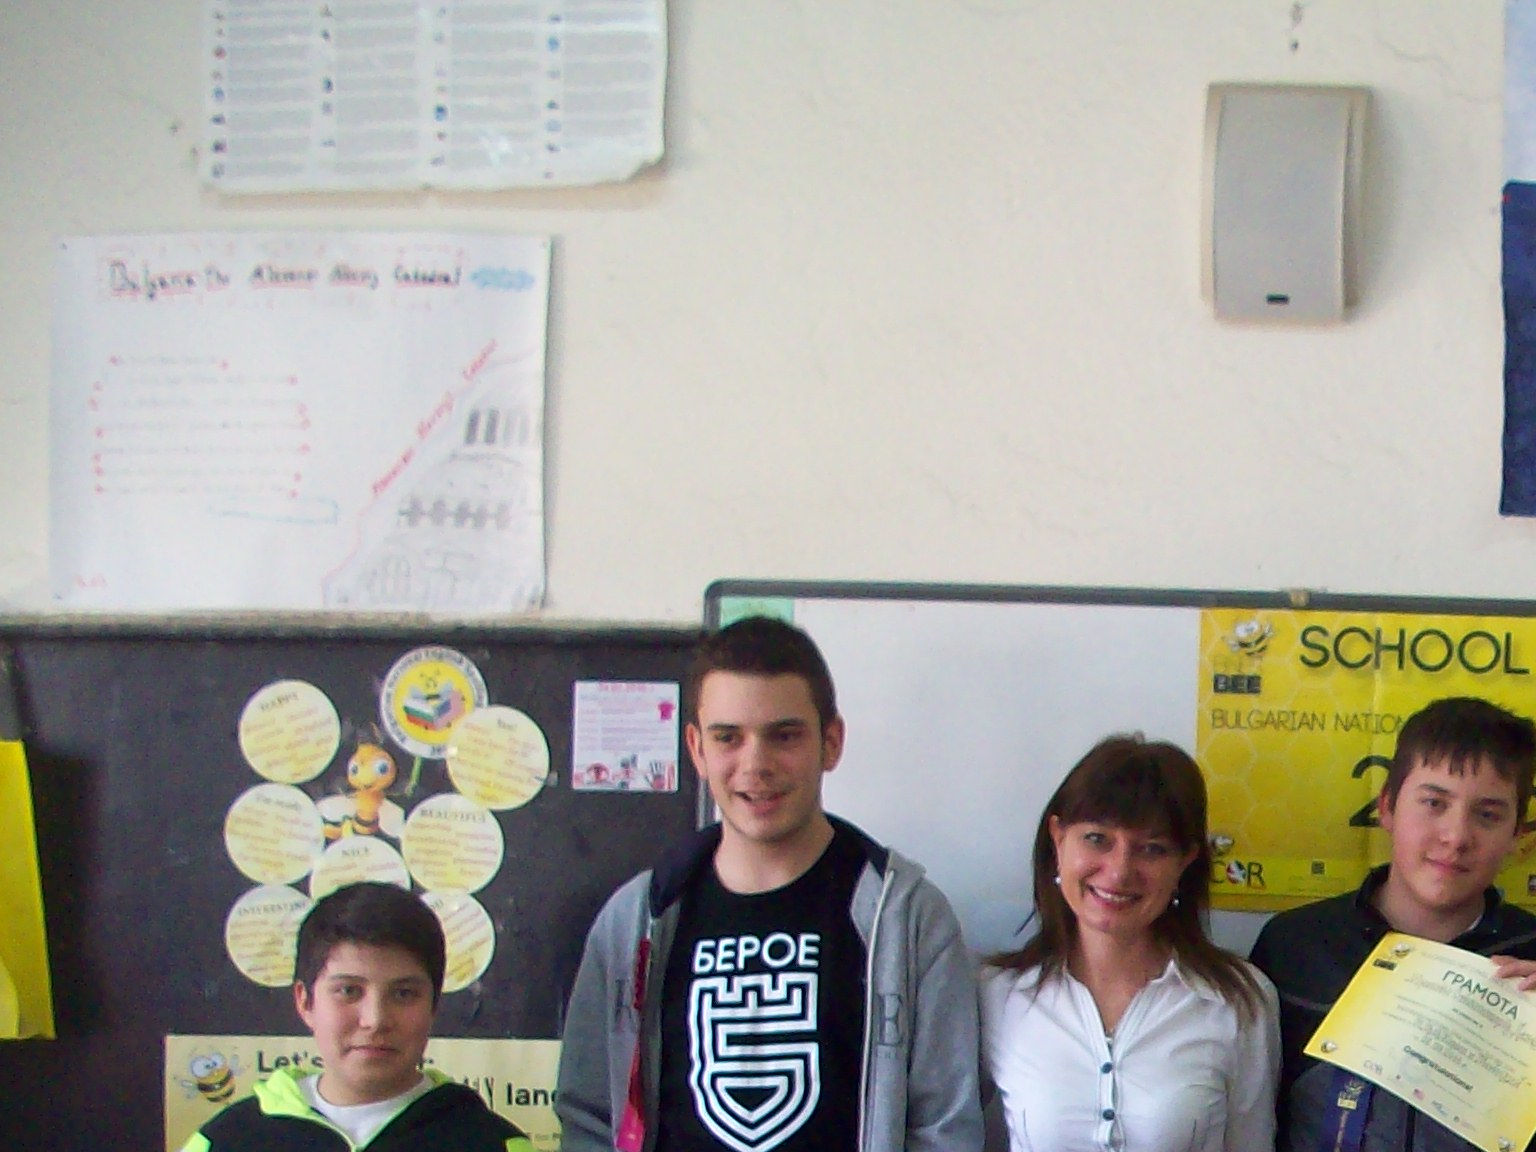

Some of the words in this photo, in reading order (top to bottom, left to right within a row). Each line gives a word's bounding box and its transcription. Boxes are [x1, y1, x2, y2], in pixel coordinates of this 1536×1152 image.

[1300, 625, 1530, 675] SCHOOL
[1211, 707, 1327, 732] BULGARIAN
[692, 932, 821, 974] БЕРОЕ
[1441, 969, 1521, 1021] ГРАМОТА
